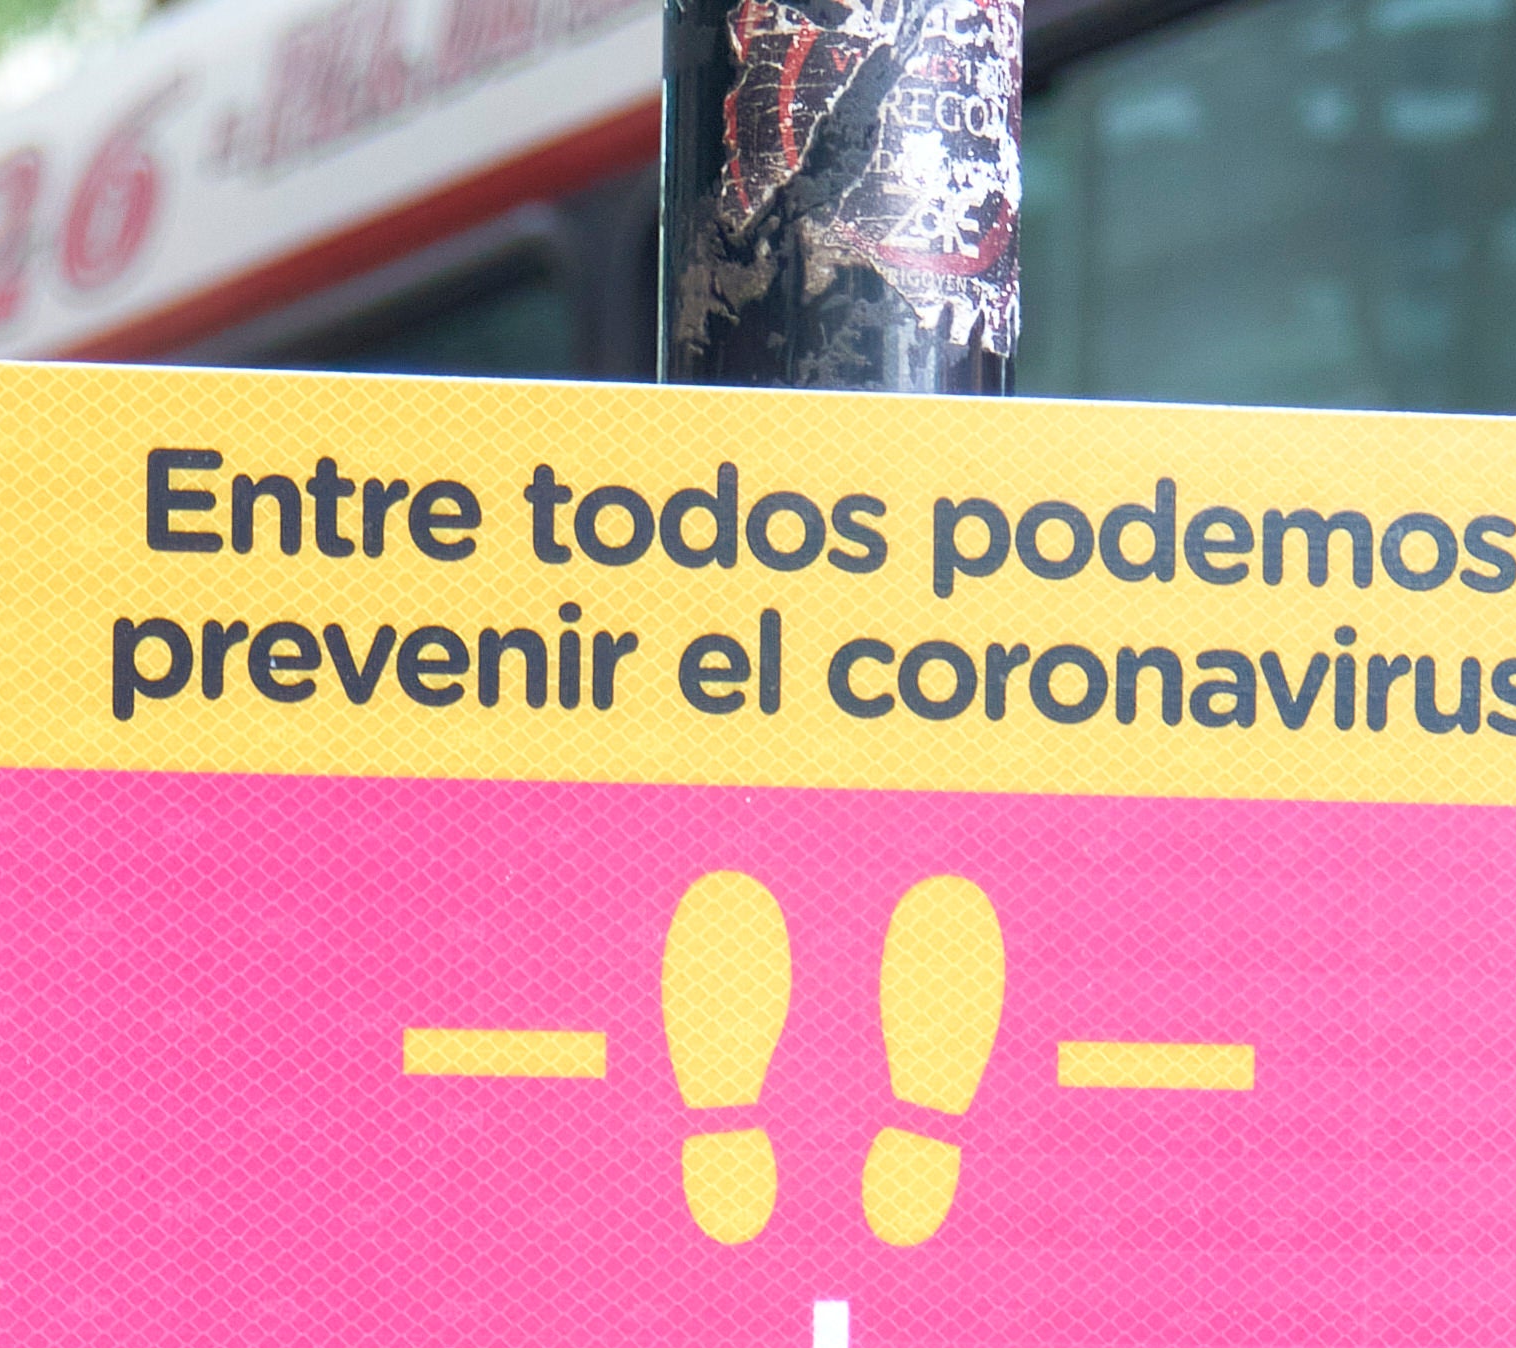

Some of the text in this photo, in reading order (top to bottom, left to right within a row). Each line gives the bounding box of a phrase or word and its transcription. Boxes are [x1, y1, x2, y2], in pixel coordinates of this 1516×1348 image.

[146, 447, 482, 562] Entre
[523, 462, 888, 574] todos
[112, 602, 639, 722] prevenir
[678, 608, 782, 715] el
